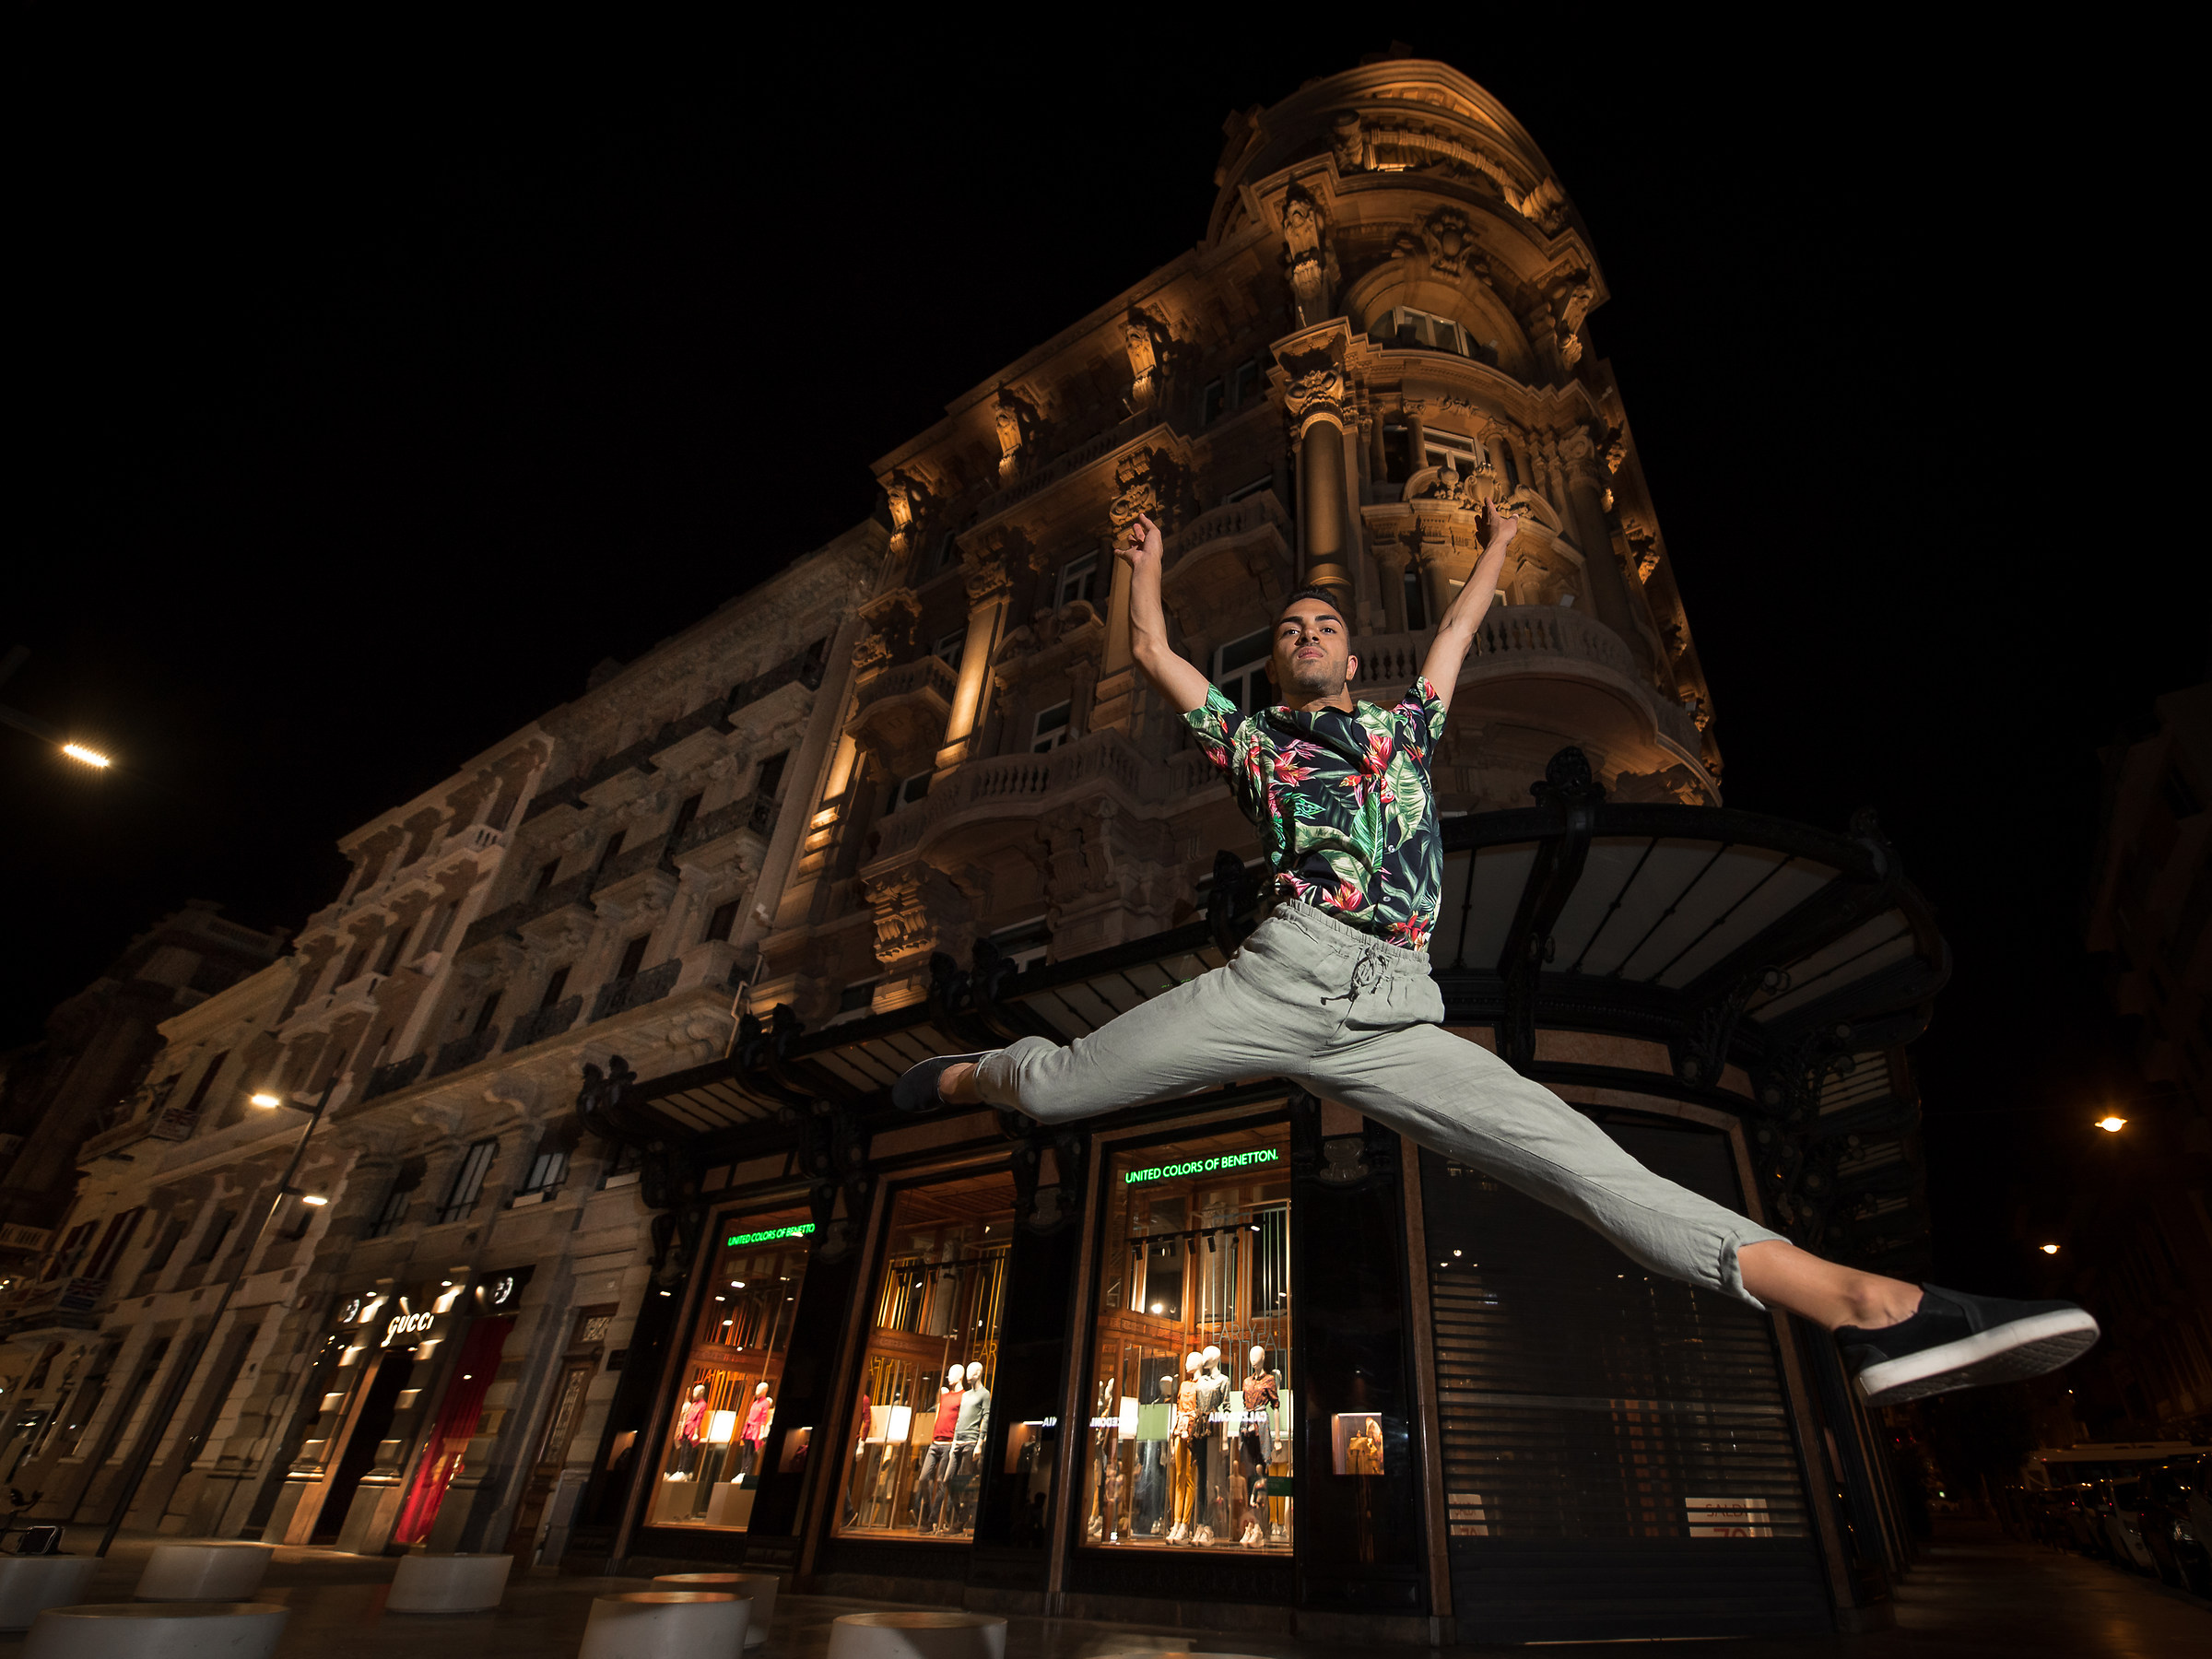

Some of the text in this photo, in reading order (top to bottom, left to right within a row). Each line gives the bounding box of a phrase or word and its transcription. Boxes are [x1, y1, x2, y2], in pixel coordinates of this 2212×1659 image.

[1125, 1148, 1278, 1184] UNITED COLORS OF BENETTON.
[727, 1222, 816, 1246] UNITED COLORS OF BENETTO
[387, 1312, 434, 1334] GUCCI
[1212, 1323, 1256, 1347] EARLY
[1257, 1332, 1287, 1351] FAL
[971, 1342, 997, 1361] EAR
